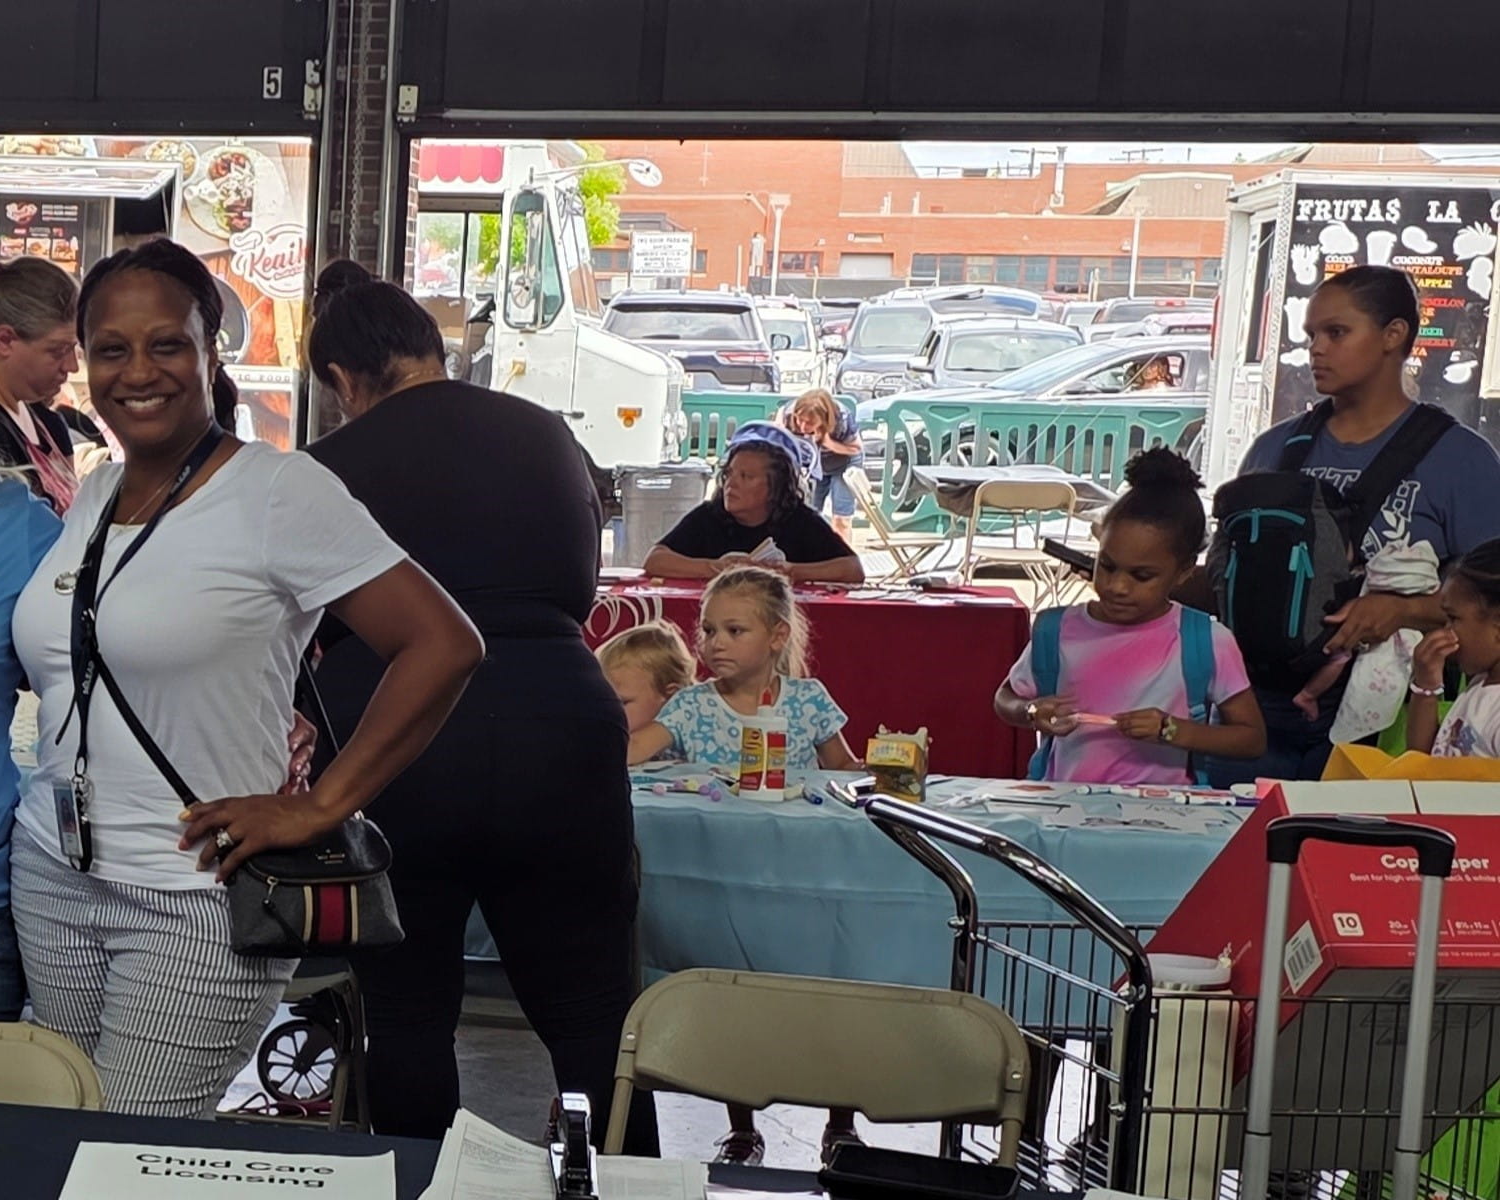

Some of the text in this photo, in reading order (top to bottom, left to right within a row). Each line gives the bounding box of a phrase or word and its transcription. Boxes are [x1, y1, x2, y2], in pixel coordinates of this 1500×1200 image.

[266, 69, 280, 97] 5
[1296, 198, 1400, 224] FRUTAS
[1426, 201, 1462, 223] LA
[1325, 254, 1355, 264] COCO
[1392, 256, 1445, 266] COCONUT
[1416, 278, 1453, 289] APPLE
[1380, 854, 1490, 873] Cop aper
[1338, 916, 1358, 929] 10
[136, 1153, 335, 1175] Child Care
[140, 1166, 325, 1188] Licensing
